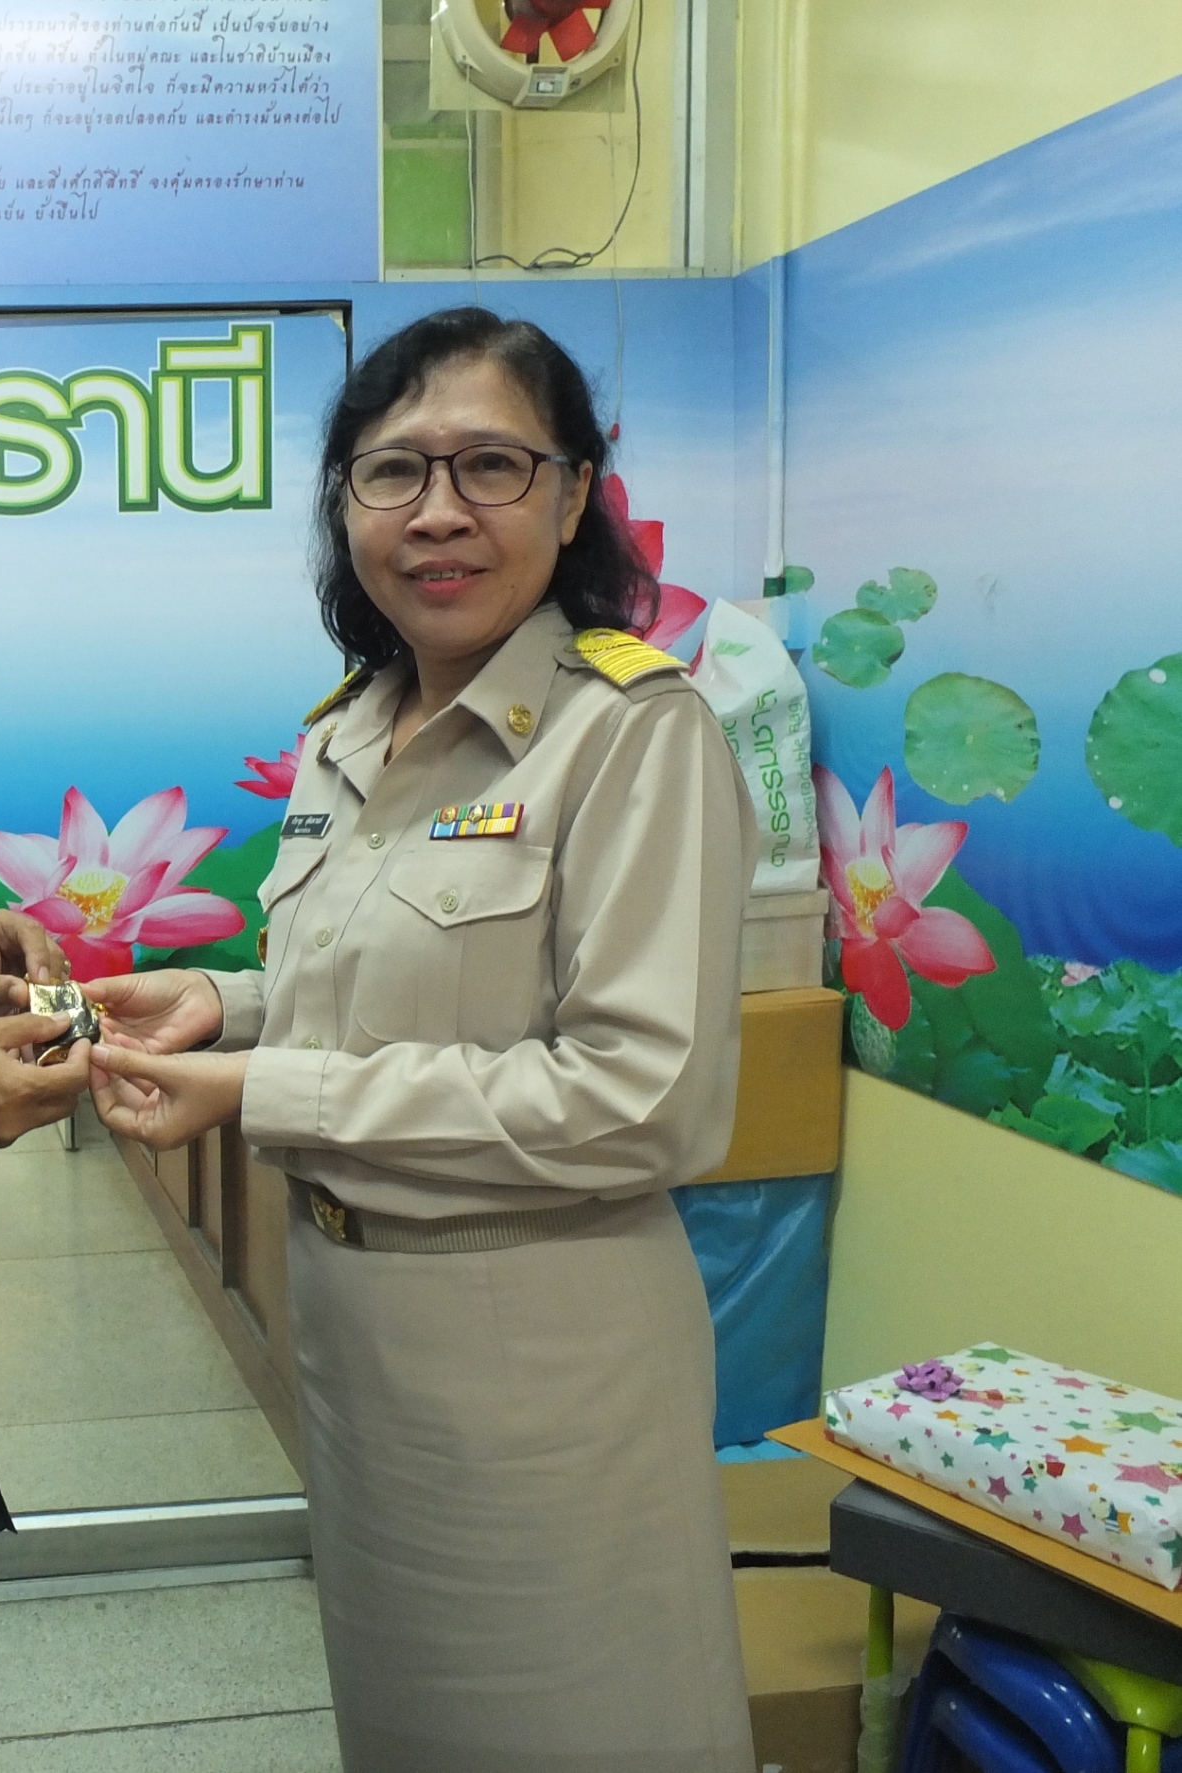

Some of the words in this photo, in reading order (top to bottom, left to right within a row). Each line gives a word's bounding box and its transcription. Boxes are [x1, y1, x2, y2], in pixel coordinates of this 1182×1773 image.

[213, 7, 330, 32] เป็นปัจจัยอย่าง
